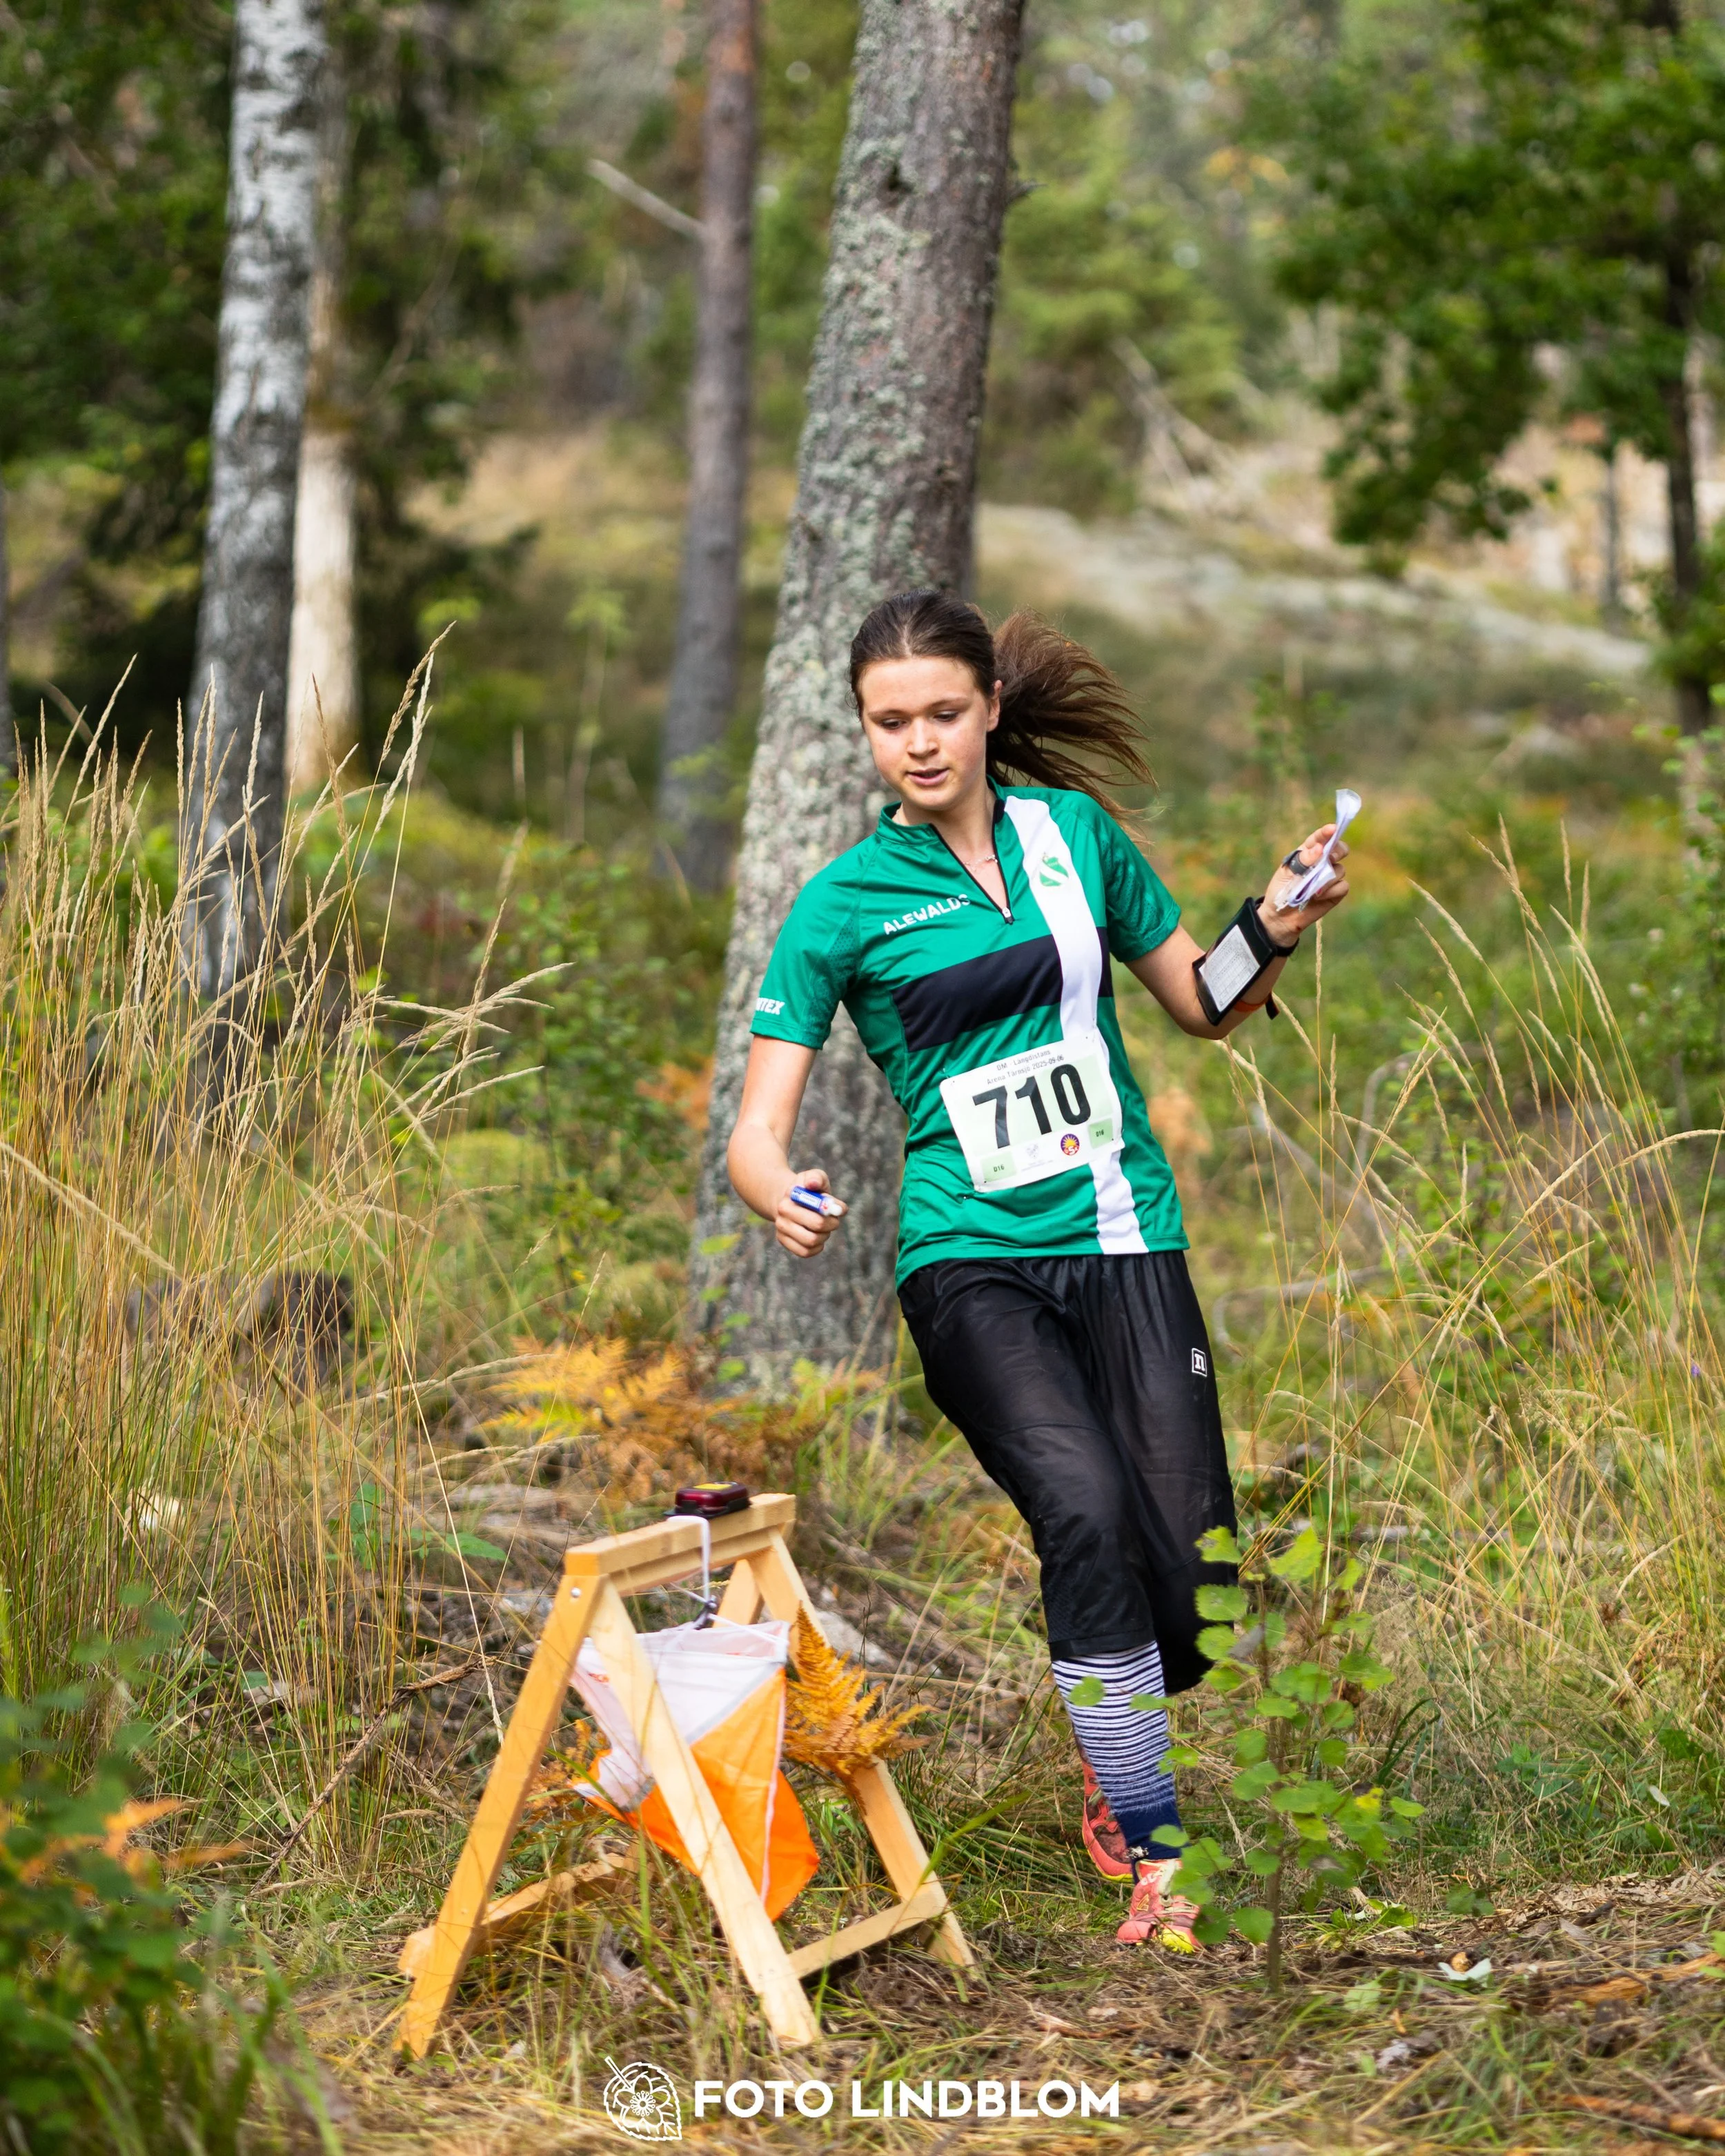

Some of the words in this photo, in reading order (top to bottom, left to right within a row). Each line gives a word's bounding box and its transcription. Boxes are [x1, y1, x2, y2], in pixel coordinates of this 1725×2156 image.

[883, 893, 971, 936] ALEWALDS
[987, 1075, 1006, 1085] Arena
[1032, 1054, 1064, 1069] 2025-09-06
[972, 1064, 1092, 1149] 710
[994, 1164, 1005, 1172] D16
